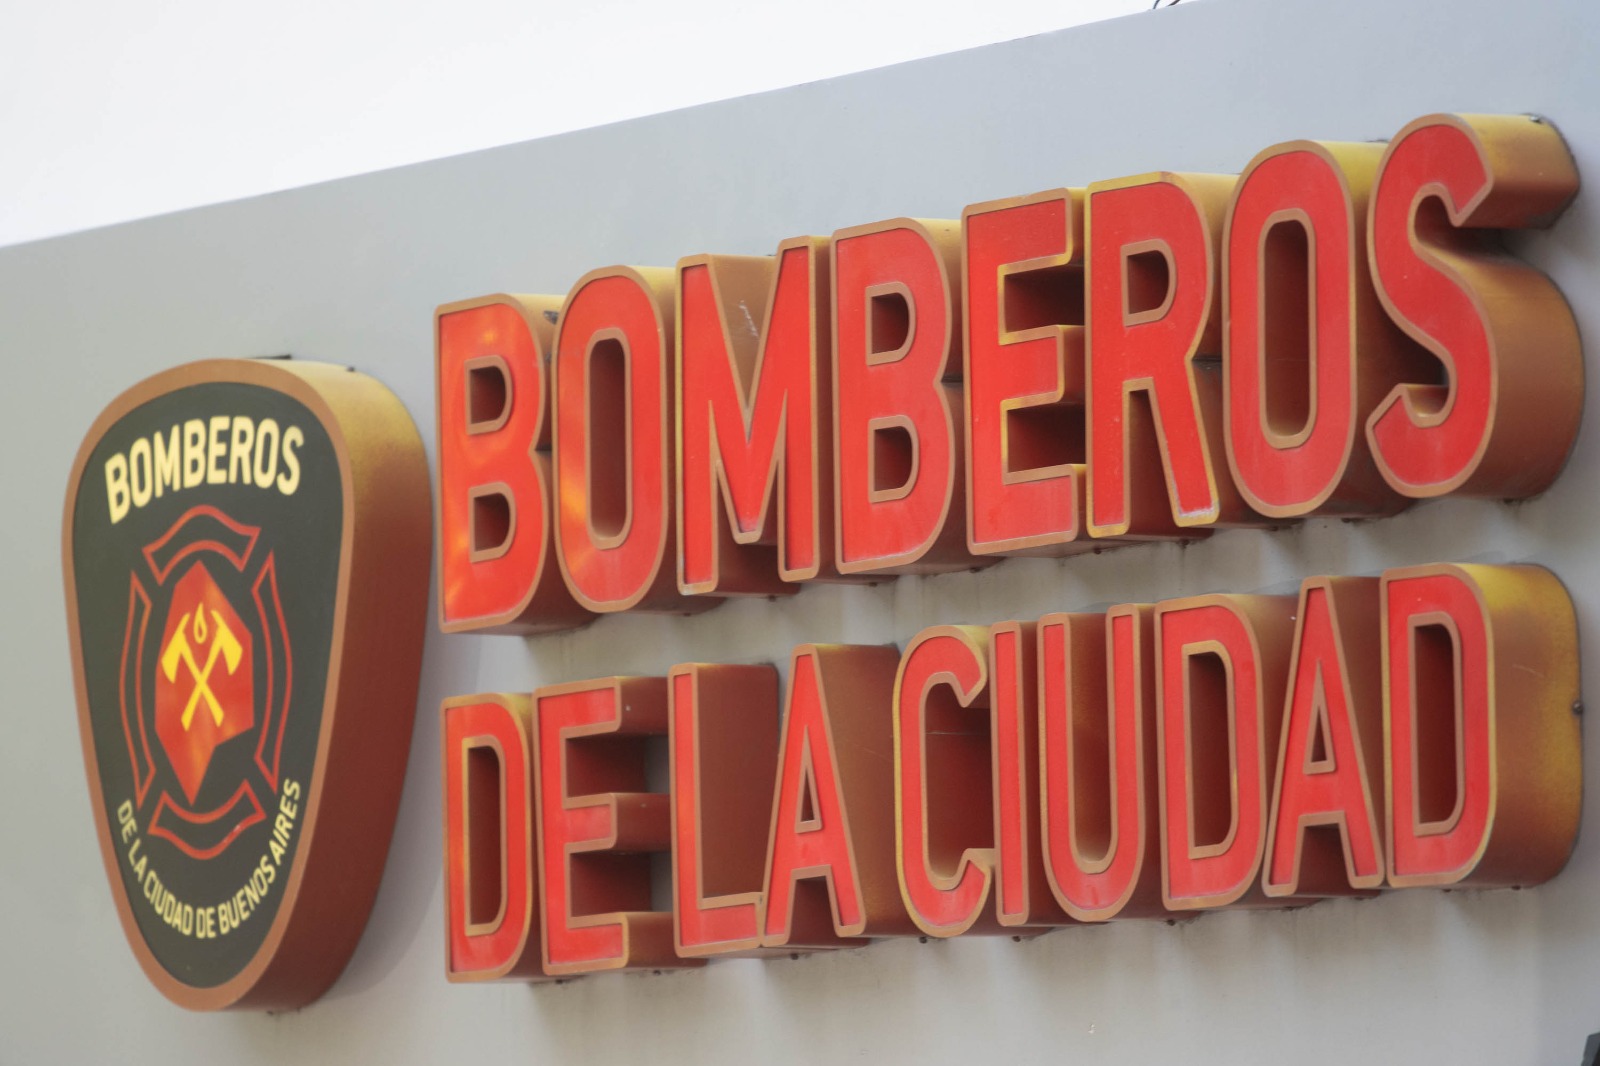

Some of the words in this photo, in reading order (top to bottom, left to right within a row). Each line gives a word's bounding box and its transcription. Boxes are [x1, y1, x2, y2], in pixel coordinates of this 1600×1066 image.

[105, 415, 304, 525] BOMBEROS
[434, 113, 1497, 634] BOMBEROS
[117, 799, 138, 844] DE
[128, 838, 148, 882] LA
[143, 869, 194, 936] CIUDAD
[196, 906, 216, 939] DE
[217, 855, 276, 935] BUENOS
[269, 778, 301, 865] AIRES
[441, 674, 629, 984] DE
[668, 643, 866, 958] LA
[892, 561, 1497, 940] CIUDAD
